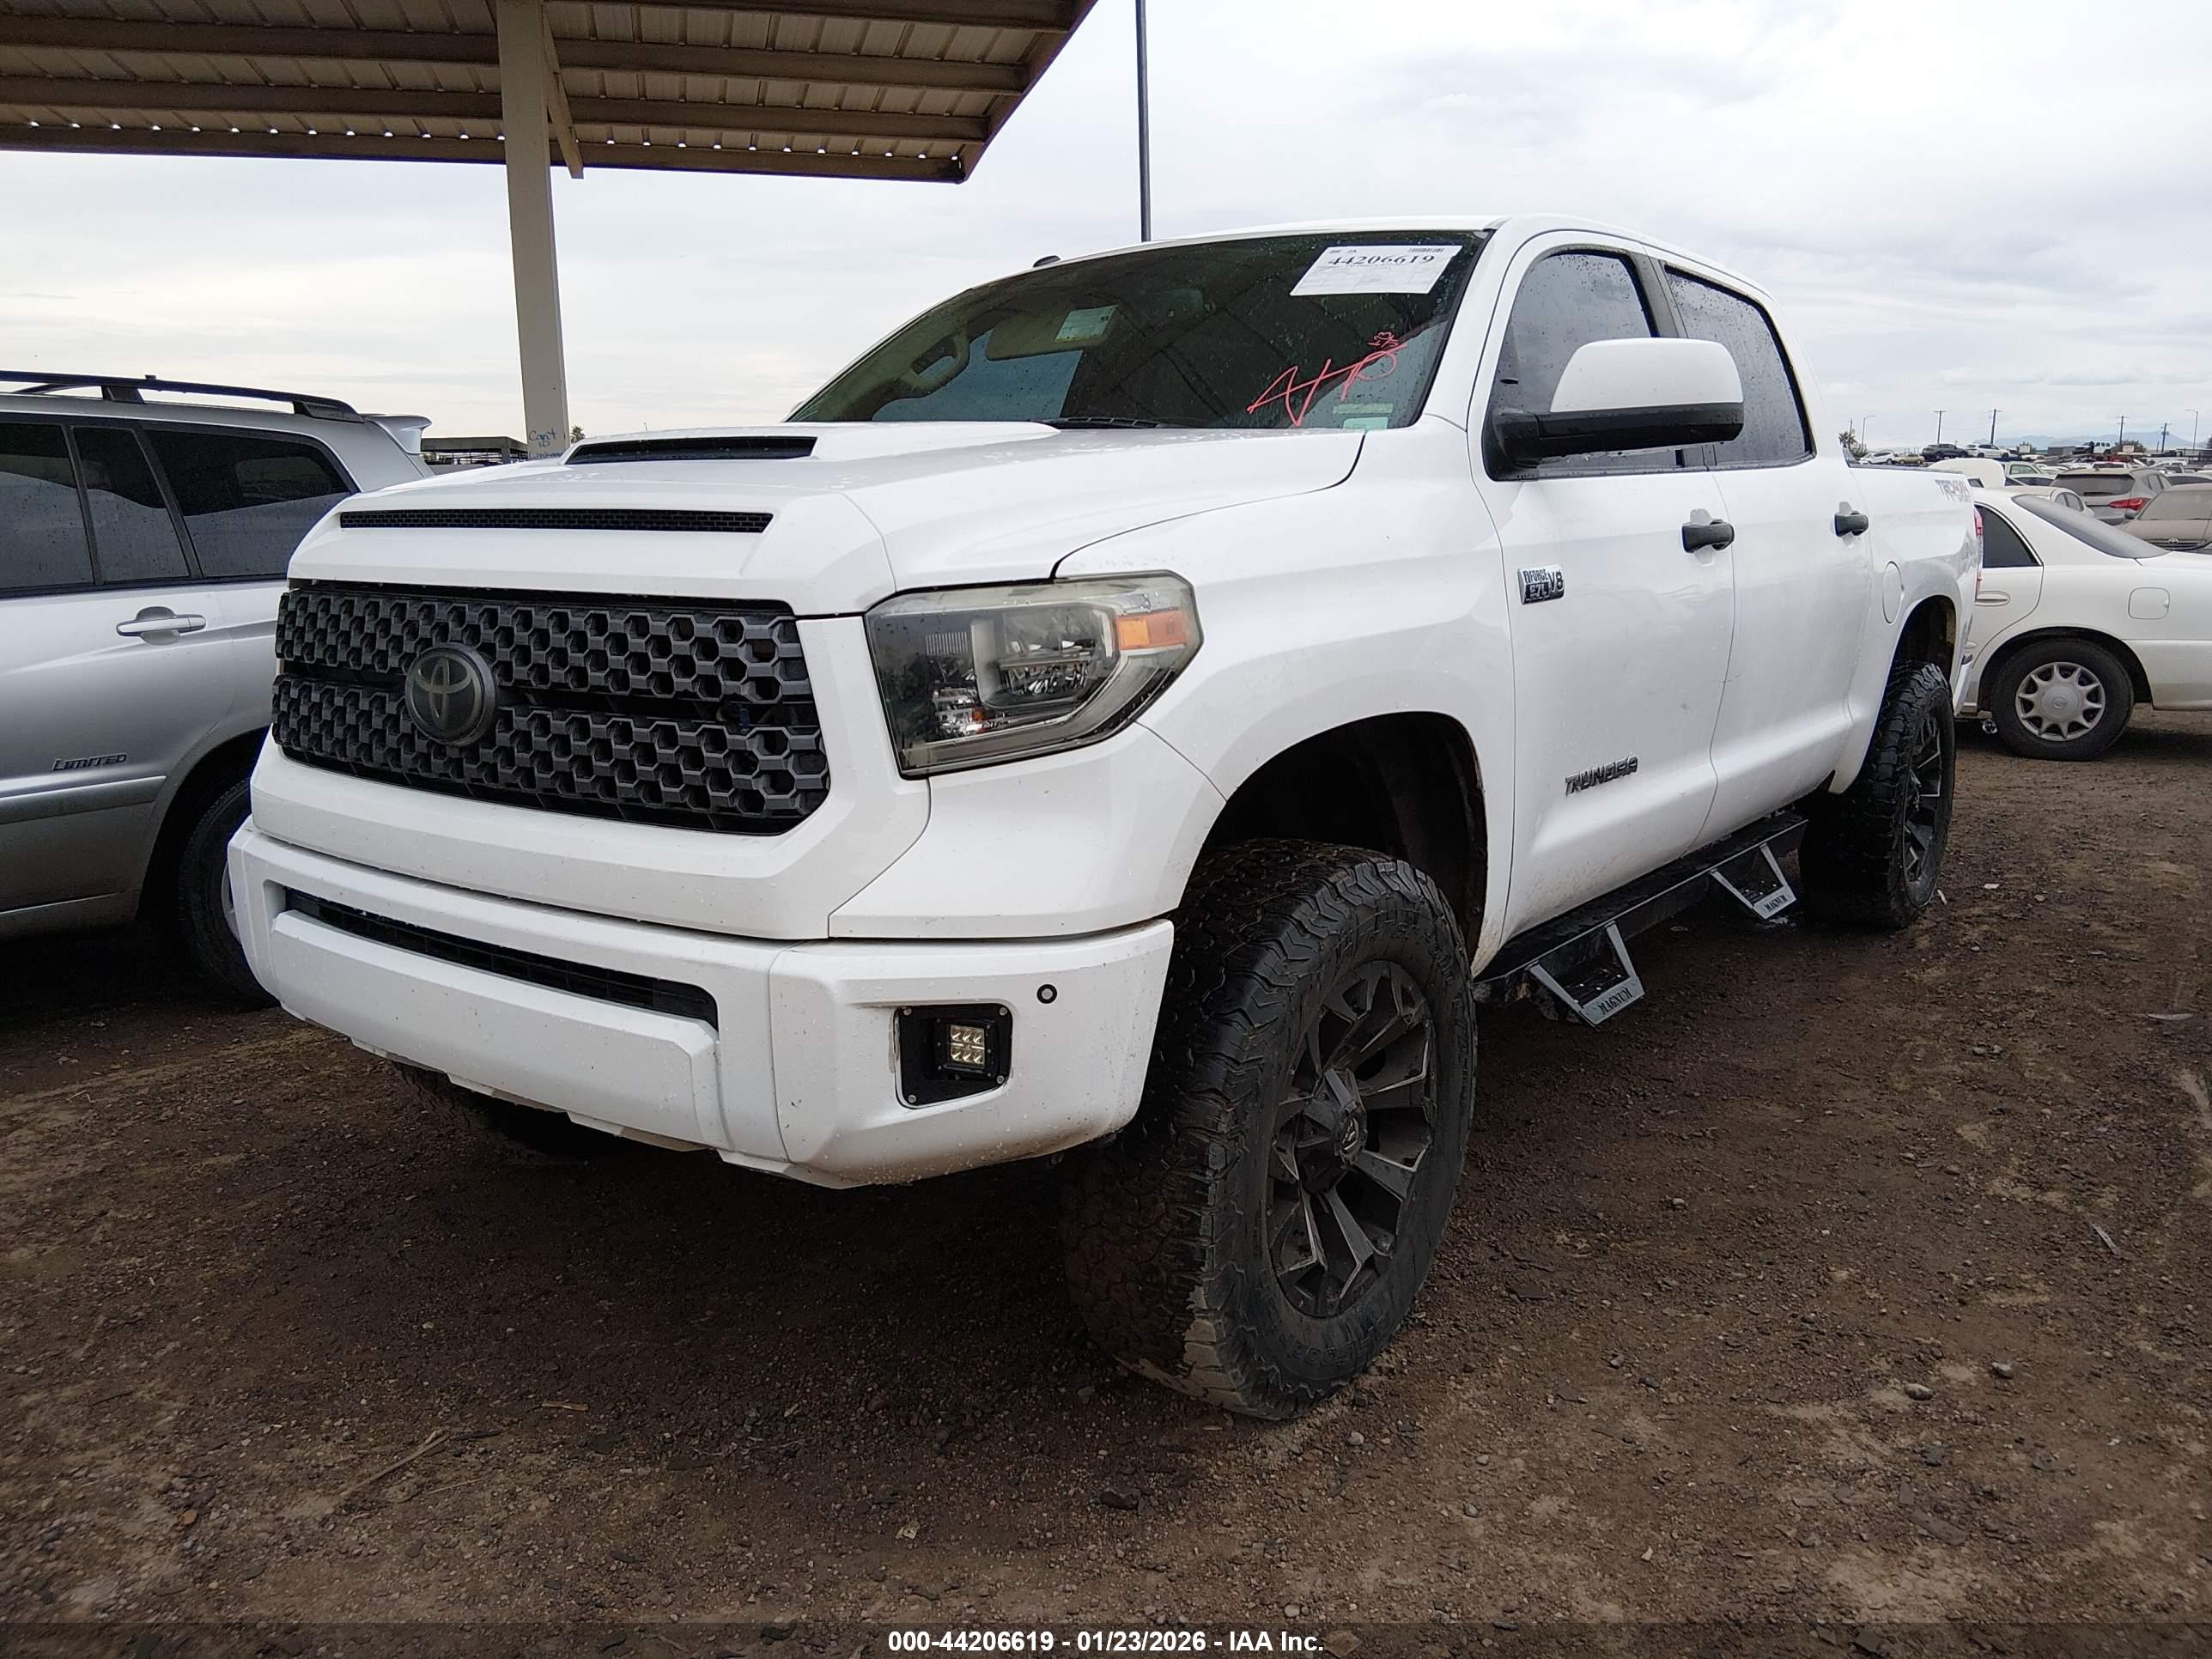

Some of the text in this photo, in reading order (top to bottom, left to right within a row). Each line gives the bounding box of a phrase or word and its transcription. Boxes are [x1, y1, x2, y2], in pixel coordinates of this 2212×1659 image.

[1328, 255, 1436, 266] 44206619
[1547, 570, 1564, 592] V8
[1565, 754, 1638, 797] TUNDRA
[1597, 987, 1633, 1016] MAGNUM
